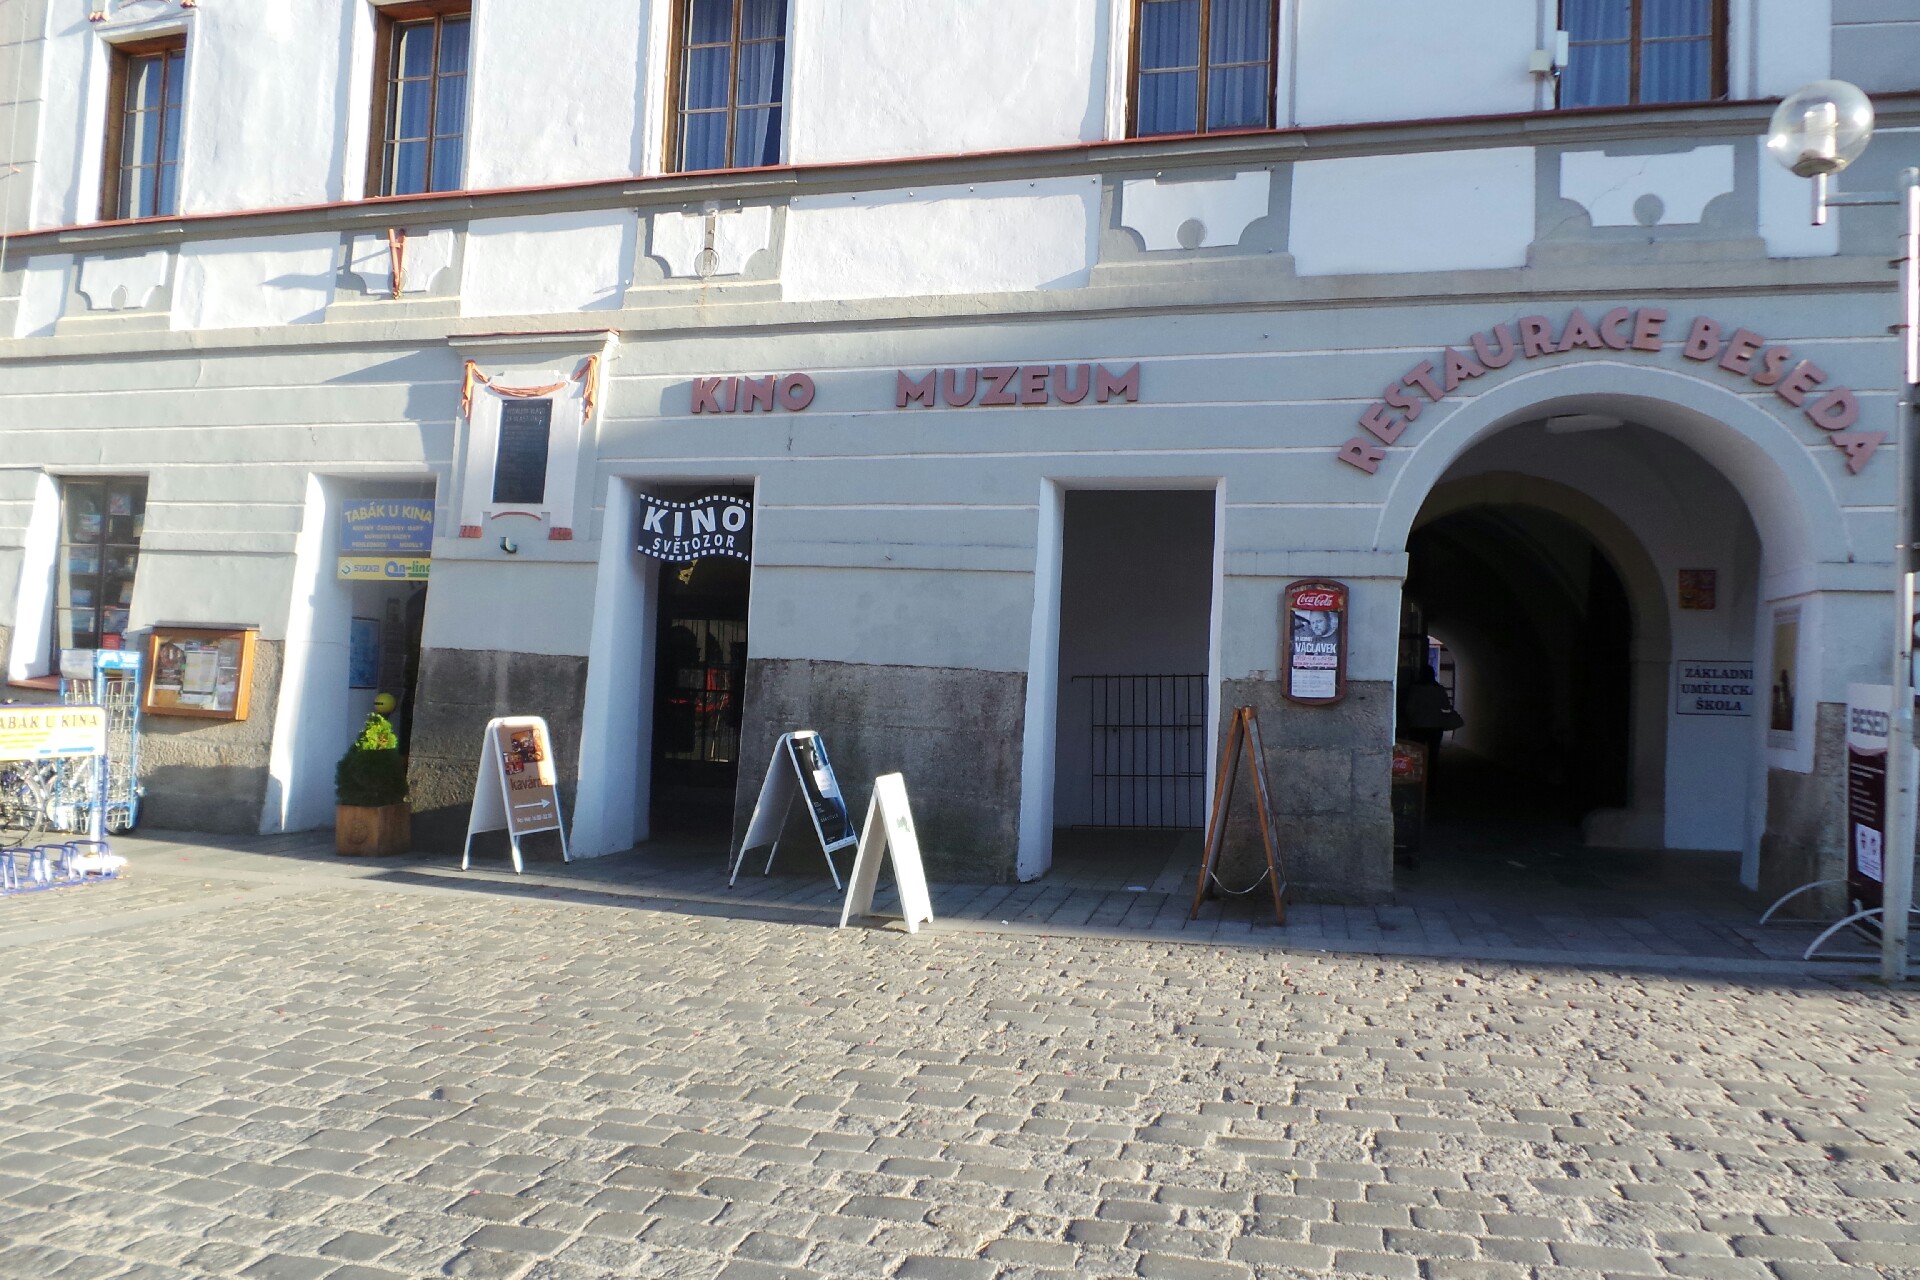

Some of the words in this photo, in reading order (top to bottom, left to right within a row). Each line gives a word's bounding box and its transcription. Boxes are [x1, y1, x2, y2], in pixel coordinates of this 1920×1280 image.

[691, 373, 815, 413] KINO
[895, 361, 1140, 408] MUZEUM
[1337, 307, 1667, 474] RESTAURACE
[1683, 316, 1887, 475] BESEDA
[344, 501, 385, 523] TABÁK
[388, 505, 399, 517] U
[402, 506, 433, 523] KINA
[642, 505, 746, 537] KINO
[652, 534, 735, 554] SVĚTOZOR
[1696, 697, 1742, 710] ŠKOLA
[510, 775, 549, 791] kavárna
